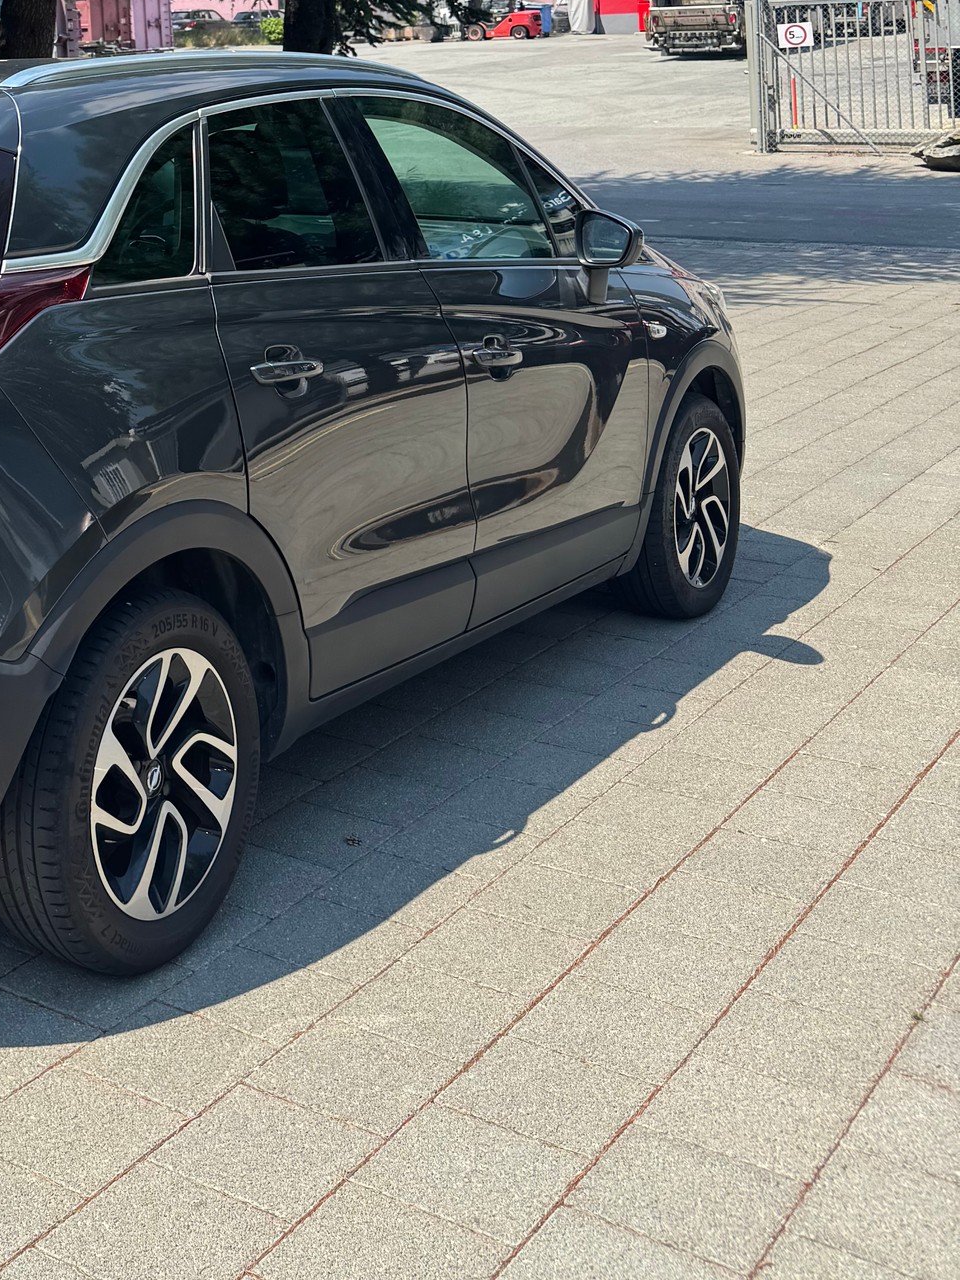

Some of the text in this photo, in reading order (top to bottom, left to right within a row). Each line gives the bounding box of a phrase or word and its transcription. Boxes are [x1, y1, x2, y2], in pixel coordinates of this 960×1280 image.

[788, 30, 795, 39] 5
[152, 613, 188, 639] 205/55
[74, 694, 111, 823] Continental
